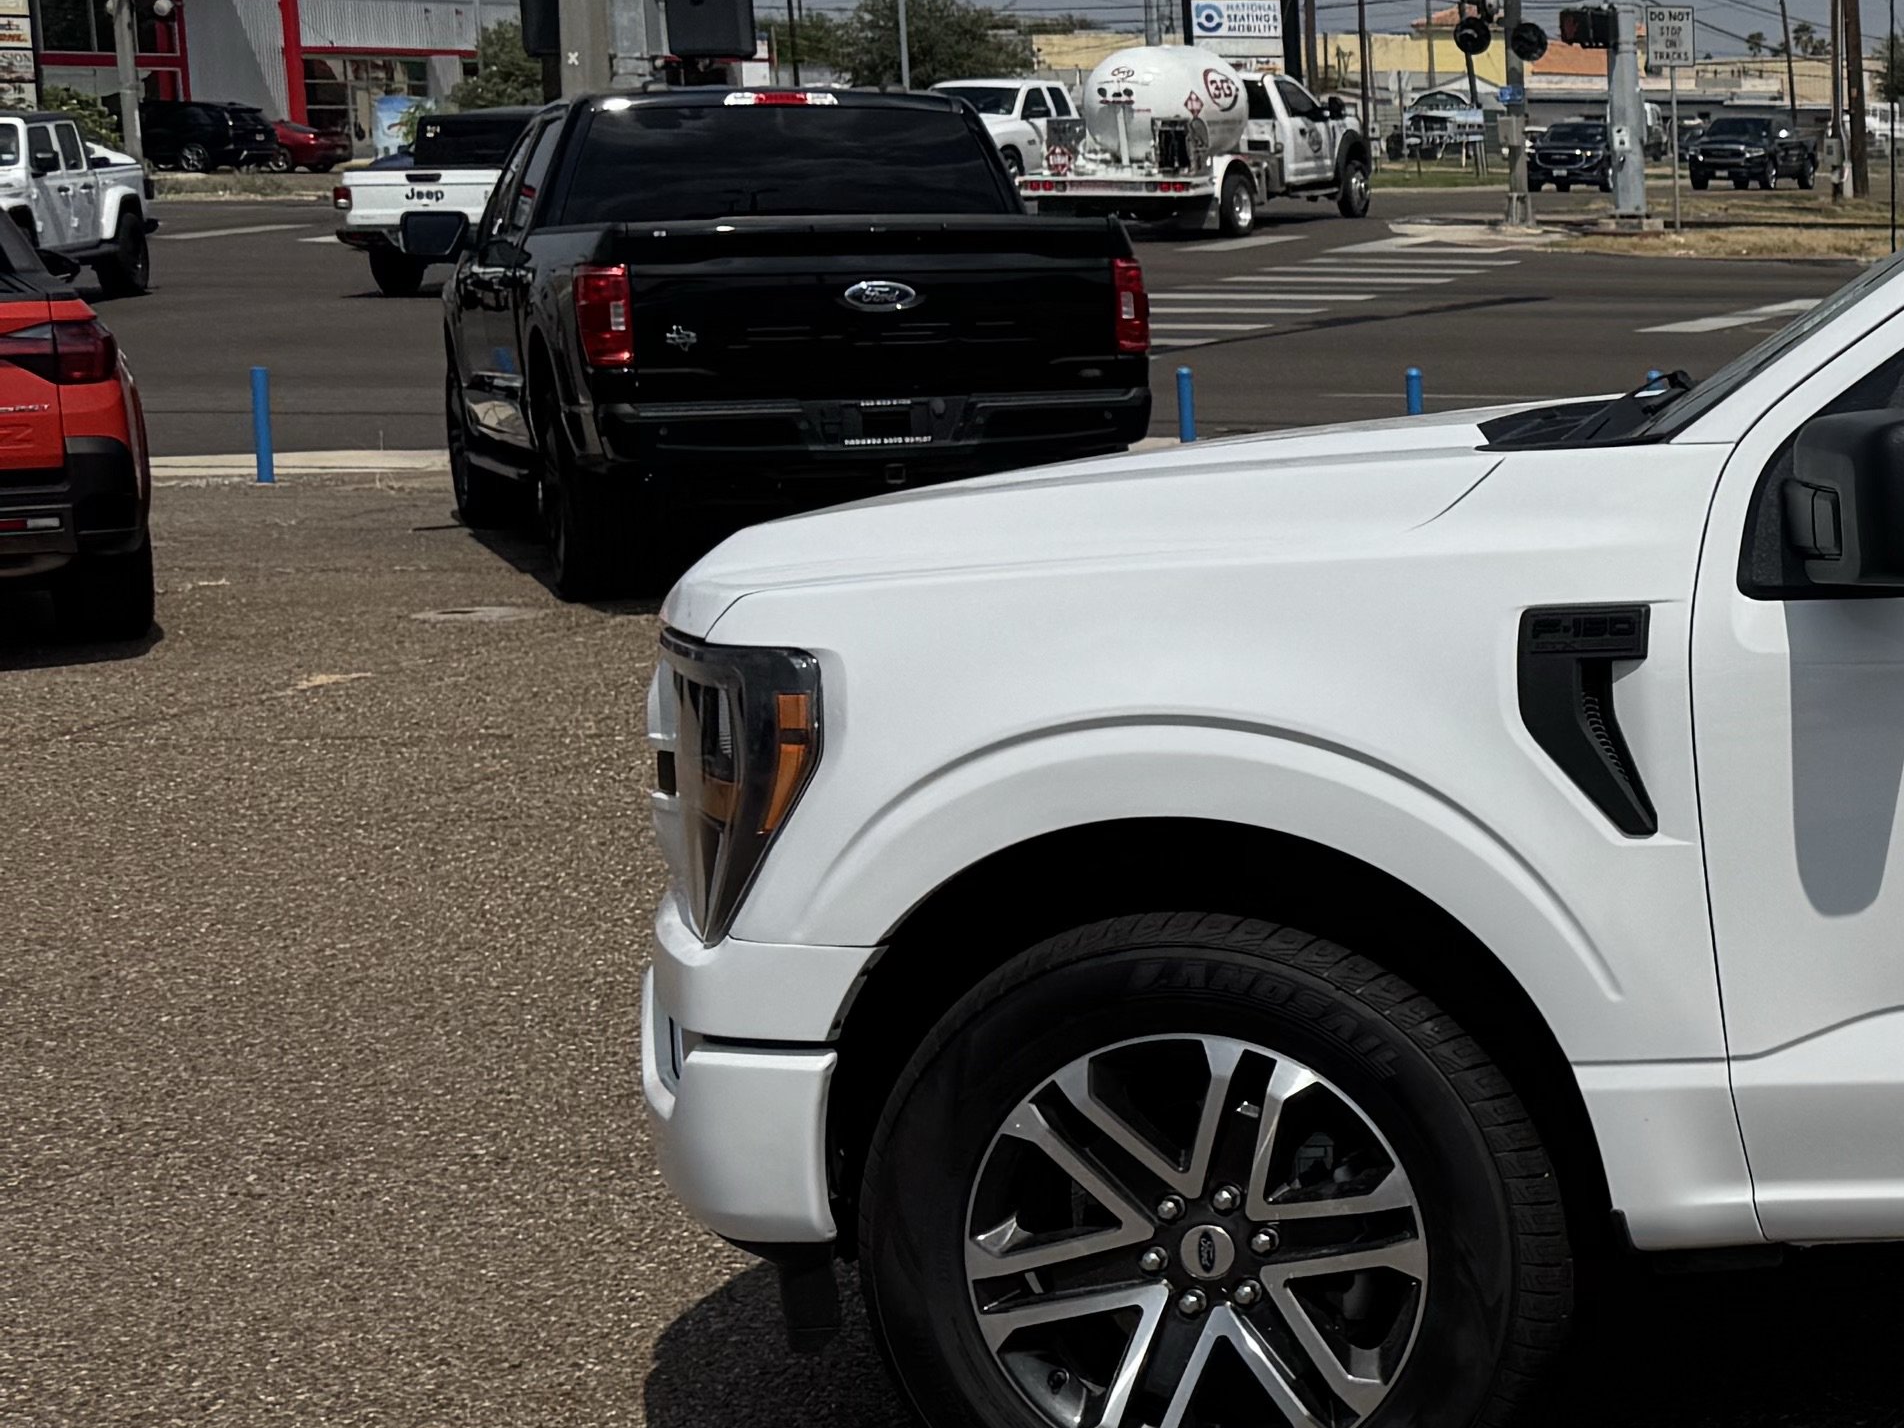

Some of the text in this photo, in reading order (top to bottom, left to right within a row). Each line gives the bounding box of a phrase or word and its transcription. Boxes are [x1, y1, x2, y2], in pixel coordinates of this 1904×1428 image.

[1226, 2, 1277, 12] NATIONAL
[1226, 13, 1270, 23] SEATING
[1650, 11, 1690, 22] DO NOT
[1227, 24, 1278, 33] MOBILITY
[1659, 26, 1682, 37] STOP
[1665, 39, 1677, 49] ON
[1653, 51, 1689, 61] TRACKS
[405, 187, 445, 203] Jeep
[862, 286, 900, 303] Ford
[1533, 616, 1635, 639] F-150
